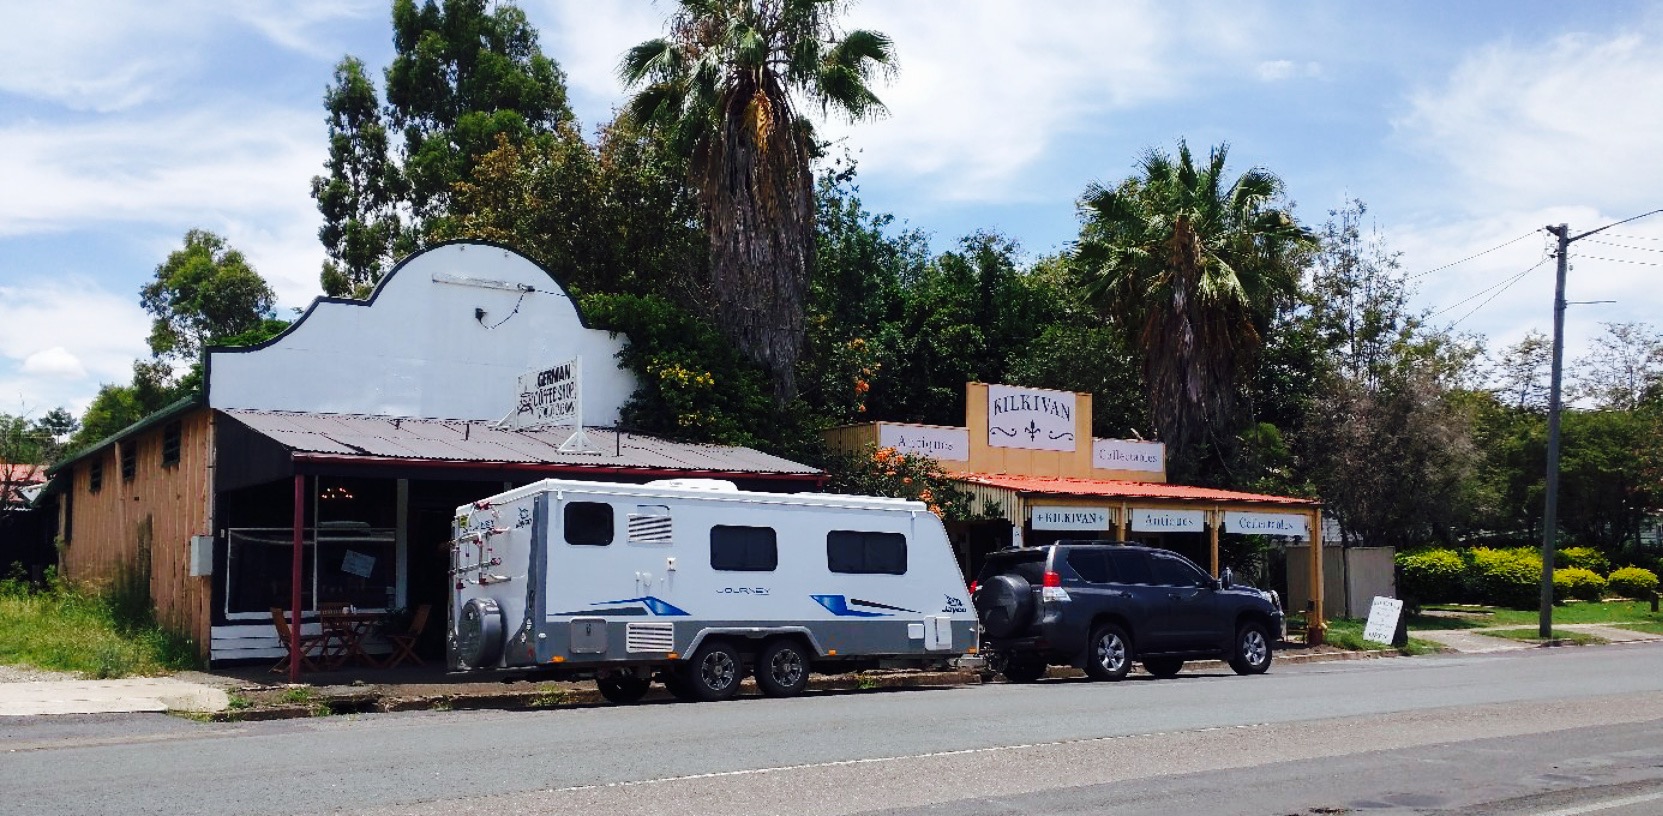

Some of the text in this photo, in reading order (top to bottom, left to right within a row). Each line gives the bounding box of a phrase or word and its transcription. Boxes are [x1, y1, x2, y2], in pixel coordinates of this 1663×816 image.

[537, 363, 571, 387] GERMAN
[994, 394, 1070, 421] KILKIVAN
[1045, 512, 1097, 524] KILKIVAN
[1145, 514, 1194, 528] Antiques
[715, 587, 771, 596] JOURNEY
